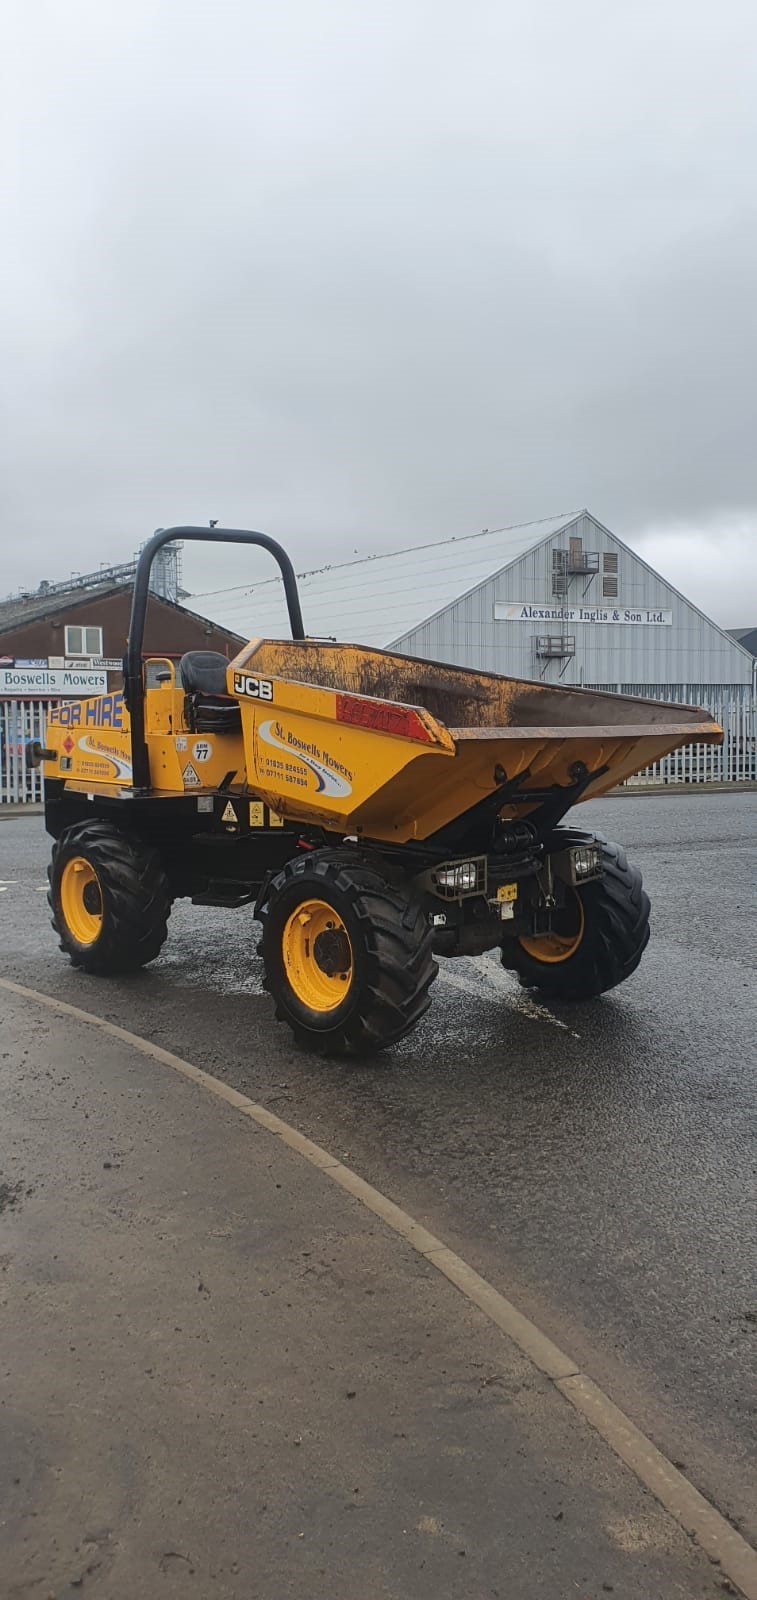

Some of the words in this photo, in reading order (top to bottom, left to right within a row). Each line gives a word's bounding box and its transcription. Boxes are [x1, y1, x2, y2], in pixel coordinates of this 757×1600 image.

[520, 606, 575, 620] Alexander
[579, 609, 608, 623] Inglis
[612, 610, 620, 621] &
[624, 610, 642, 622] Son
[646, 611, 665, 623] Ltd.
[5, 672, 56, 685] Boswells
[63, 673, 105, 686] Mowers
[235, 676, 273, 701] JCB
[50, 704, 81, 726] FOR
[86, 694, 123, 727] HIRE
[196, 749, 209, 760] 77
[275, 721, 286, 740] St.
[287, 732, 321, 758] Boswells
[322, 751, 353, 781] Mowers
